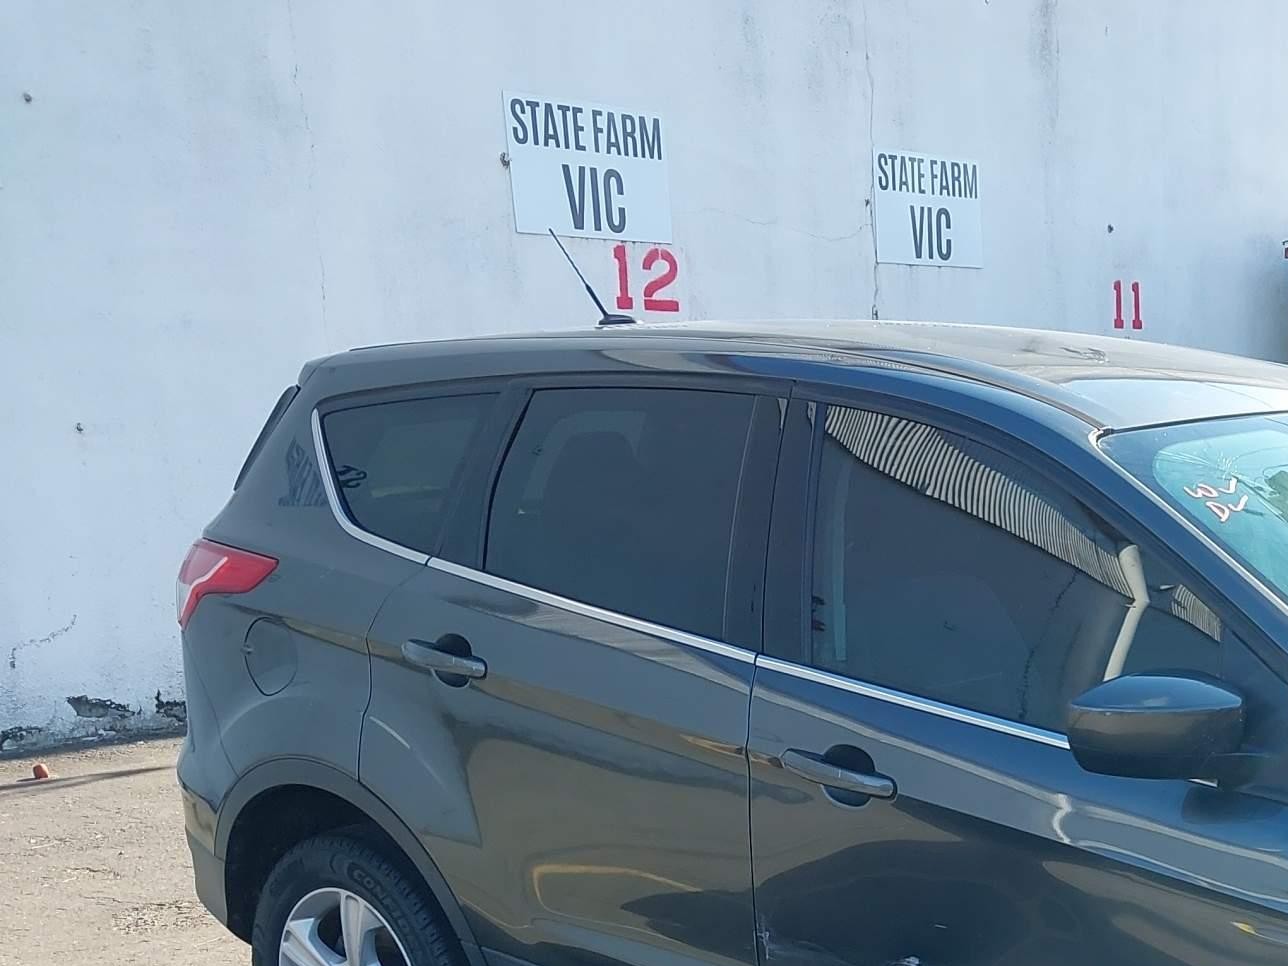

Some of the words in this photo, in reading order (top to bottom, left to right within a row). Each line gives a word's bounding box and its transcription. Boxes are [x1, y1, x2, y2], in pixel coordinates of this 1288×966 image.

[510, 98, 587, 151] STATE
[591, 109, 662, 161] FARM
[561, 163, 627, 234] VIC
[877, 152, 926, 194] STATE
[930, 159, 978, 199] FARM
[910, 205, 952, 261] VIC
[613, 245, 680, 312] 12
[1113, 279, 1143, 330] 11
